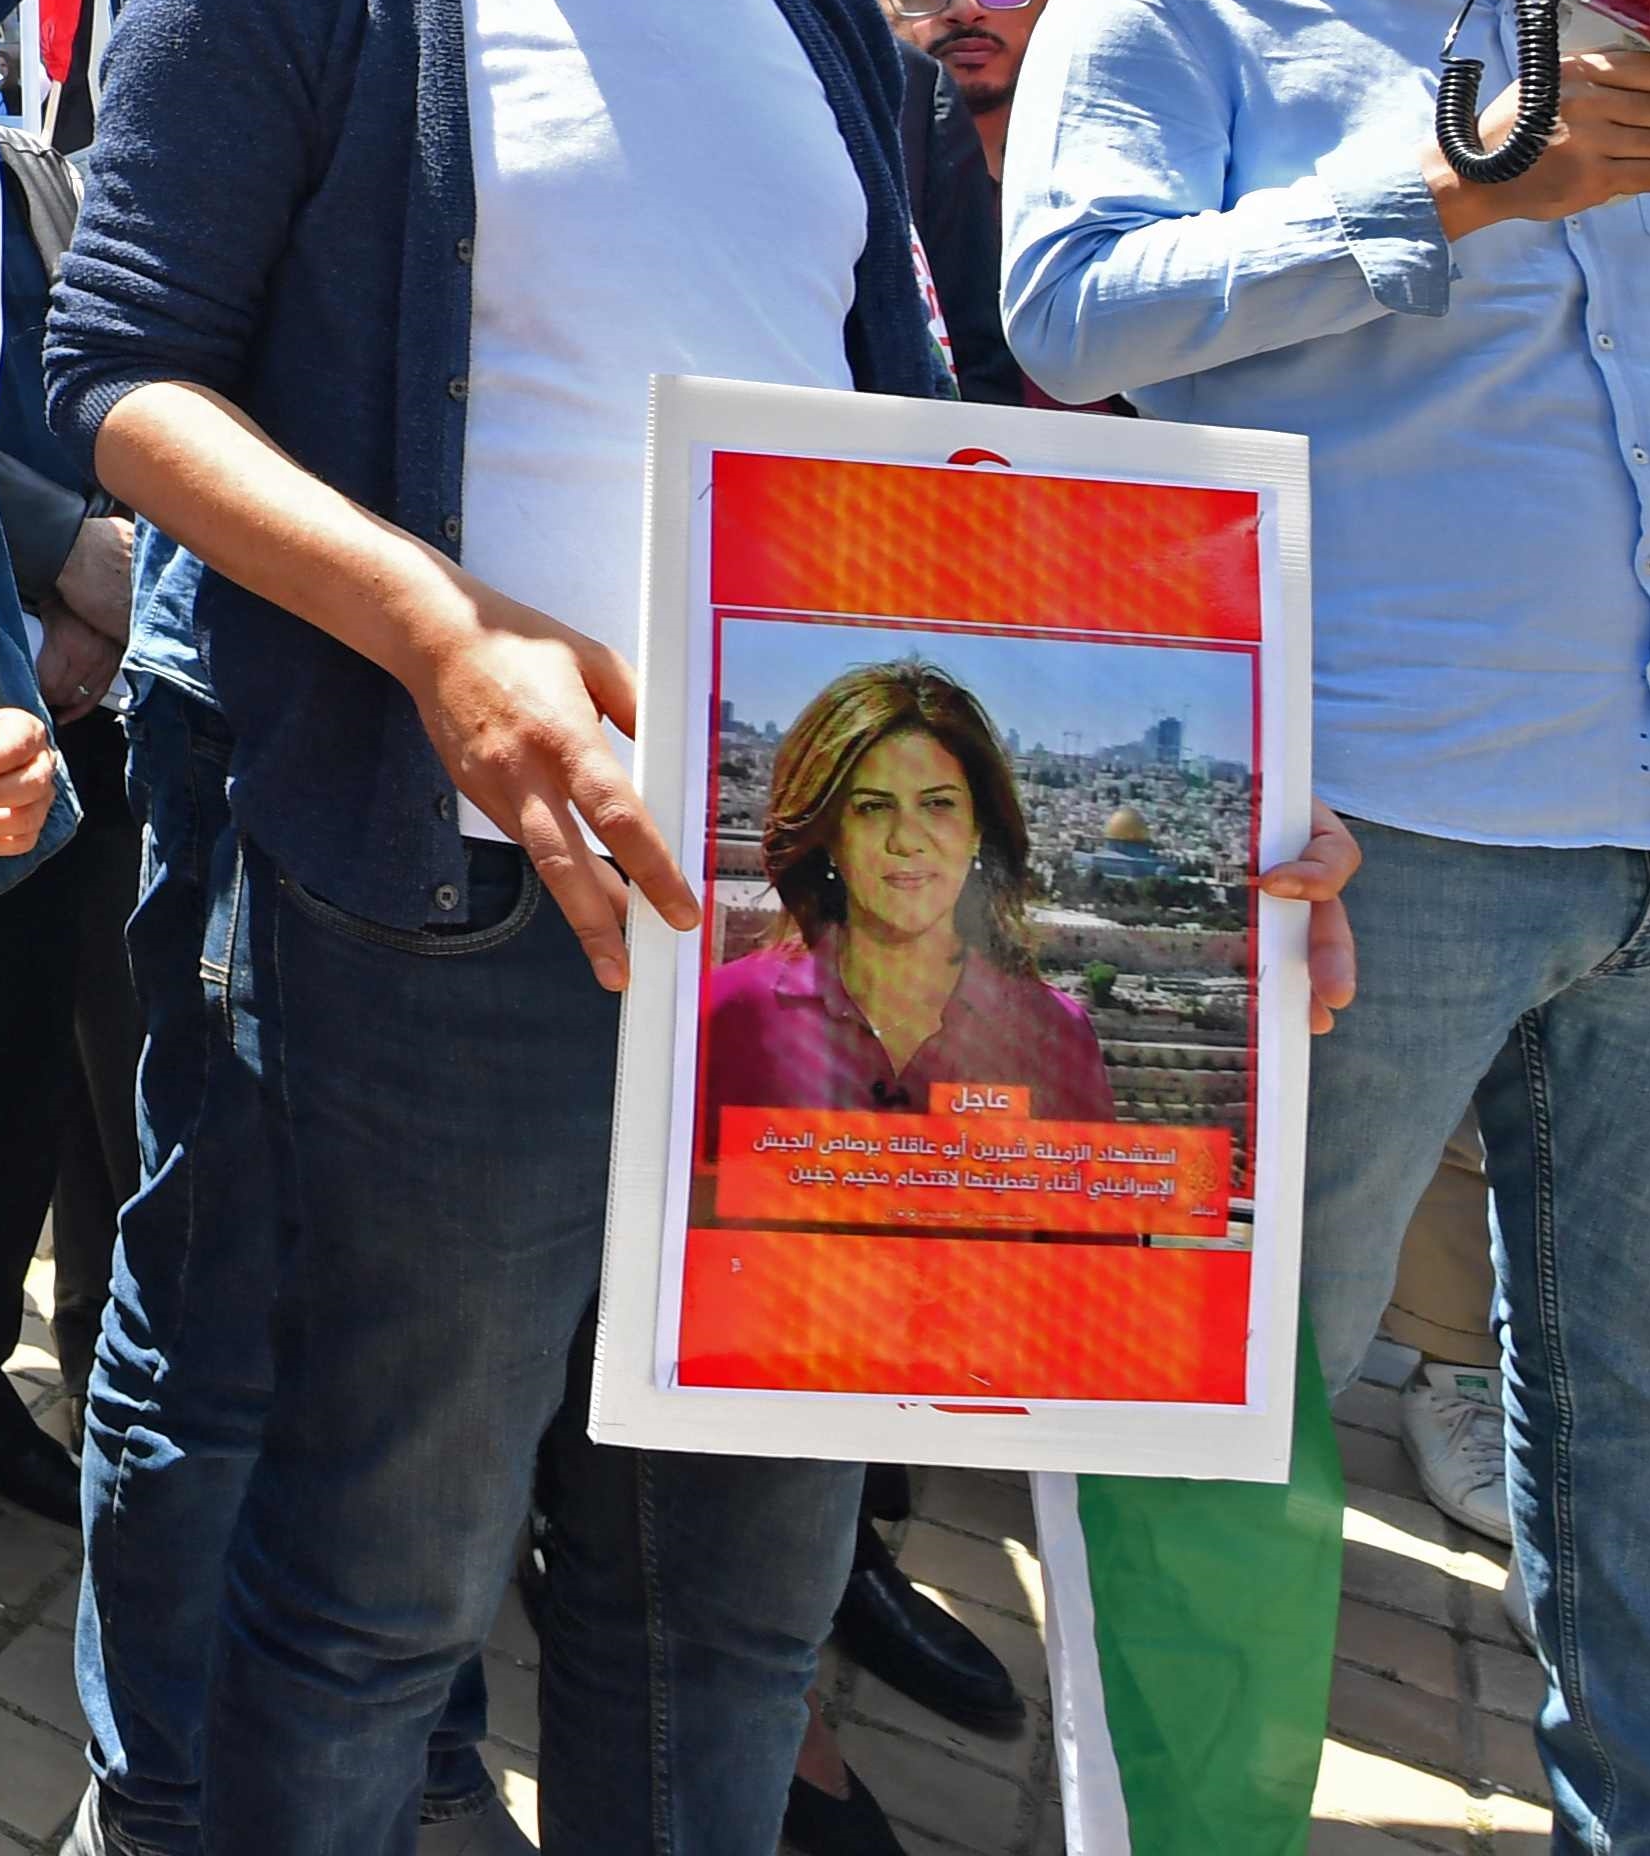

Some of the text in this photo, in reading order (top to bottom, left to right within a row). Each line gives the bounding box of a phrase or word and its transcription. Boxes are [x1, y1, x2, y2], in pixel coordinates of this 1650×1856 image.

[951, 1086, 1009, 1113] عاجل
[753, 1126, 1177, 1166] استشهاد الزميلة شيرين أبو عاقلة برصاص الجيش
[787, 1164, 1176, 1202] الإسرائيلي أثناء تغطيتها لاقتحام مخيم جنين
